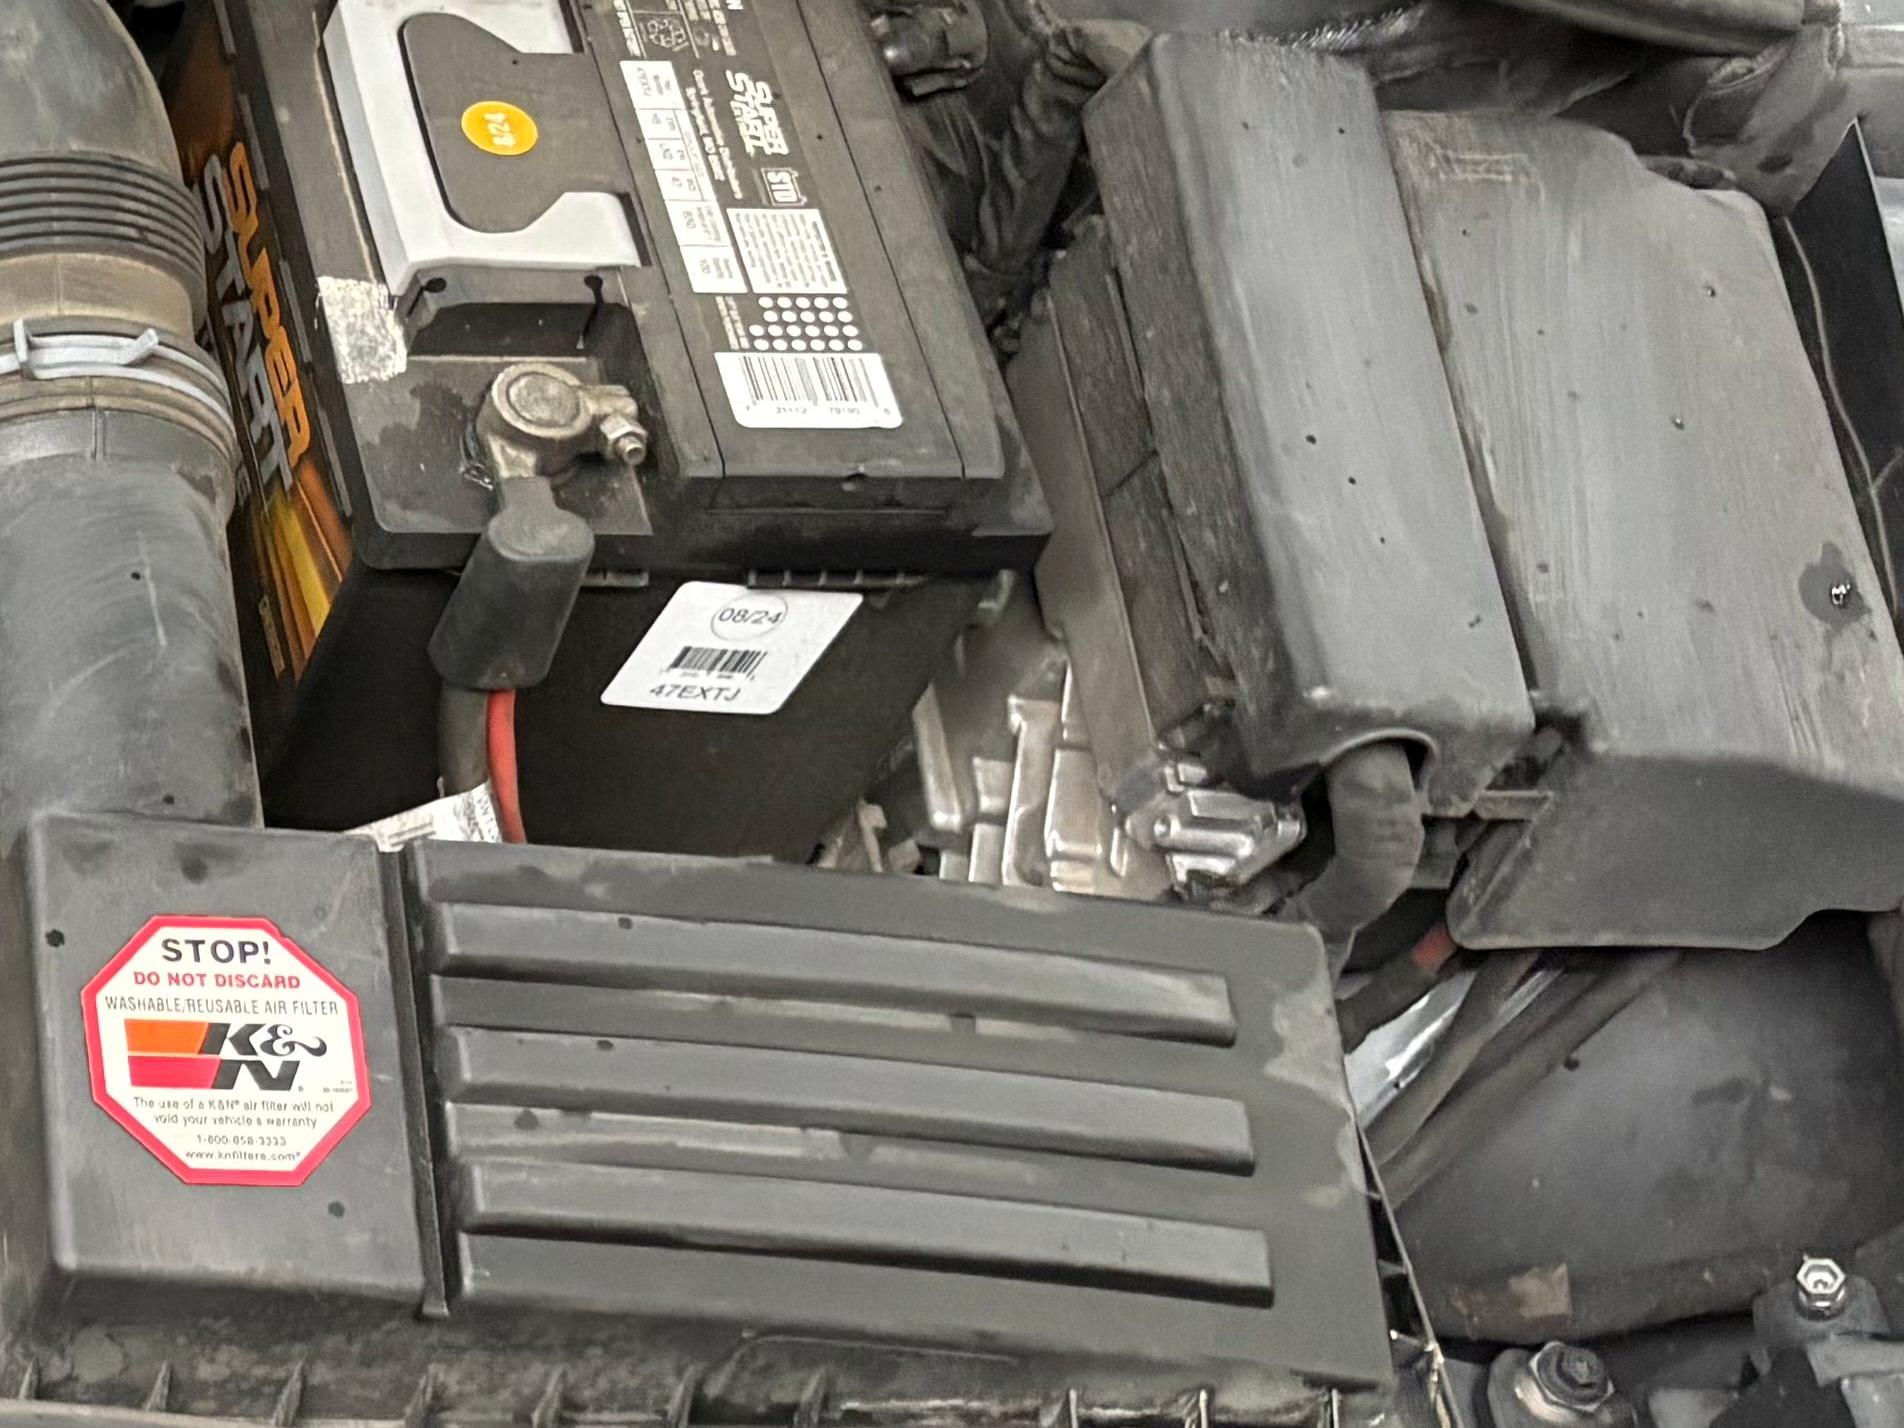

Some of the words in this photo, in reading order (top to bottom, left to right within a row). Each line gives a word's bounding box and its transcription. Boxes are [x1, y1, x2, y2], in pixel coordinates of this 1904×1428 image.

[725, 69, 772, 156] START
[754, 81, 790, 156] SUPER
[766, 171, 798, 203] STD
[227, 139, 312, 472] SUPER
[203, 153, 293, 491] START
[718, 607, 785, 626] 08/24
[649, 683, 743, 702] 47EXTJ
[161, 938, 272, 965] STOP!
[133, 971, 160, 987] DO
[168, 972, 207, 988] NOT
[214, 973, 301, 990] DISCARD
[105, 996, 259, 1015] WASHABLE/REUSABLE
[264, 999, 287, 1015] AIR
[293, 1000, 339, 1015] FILTER
[133, 1096, 154, 1109] The
[314, 1099, 334, 1113] not
[183, 1116, 208, 1129] your
